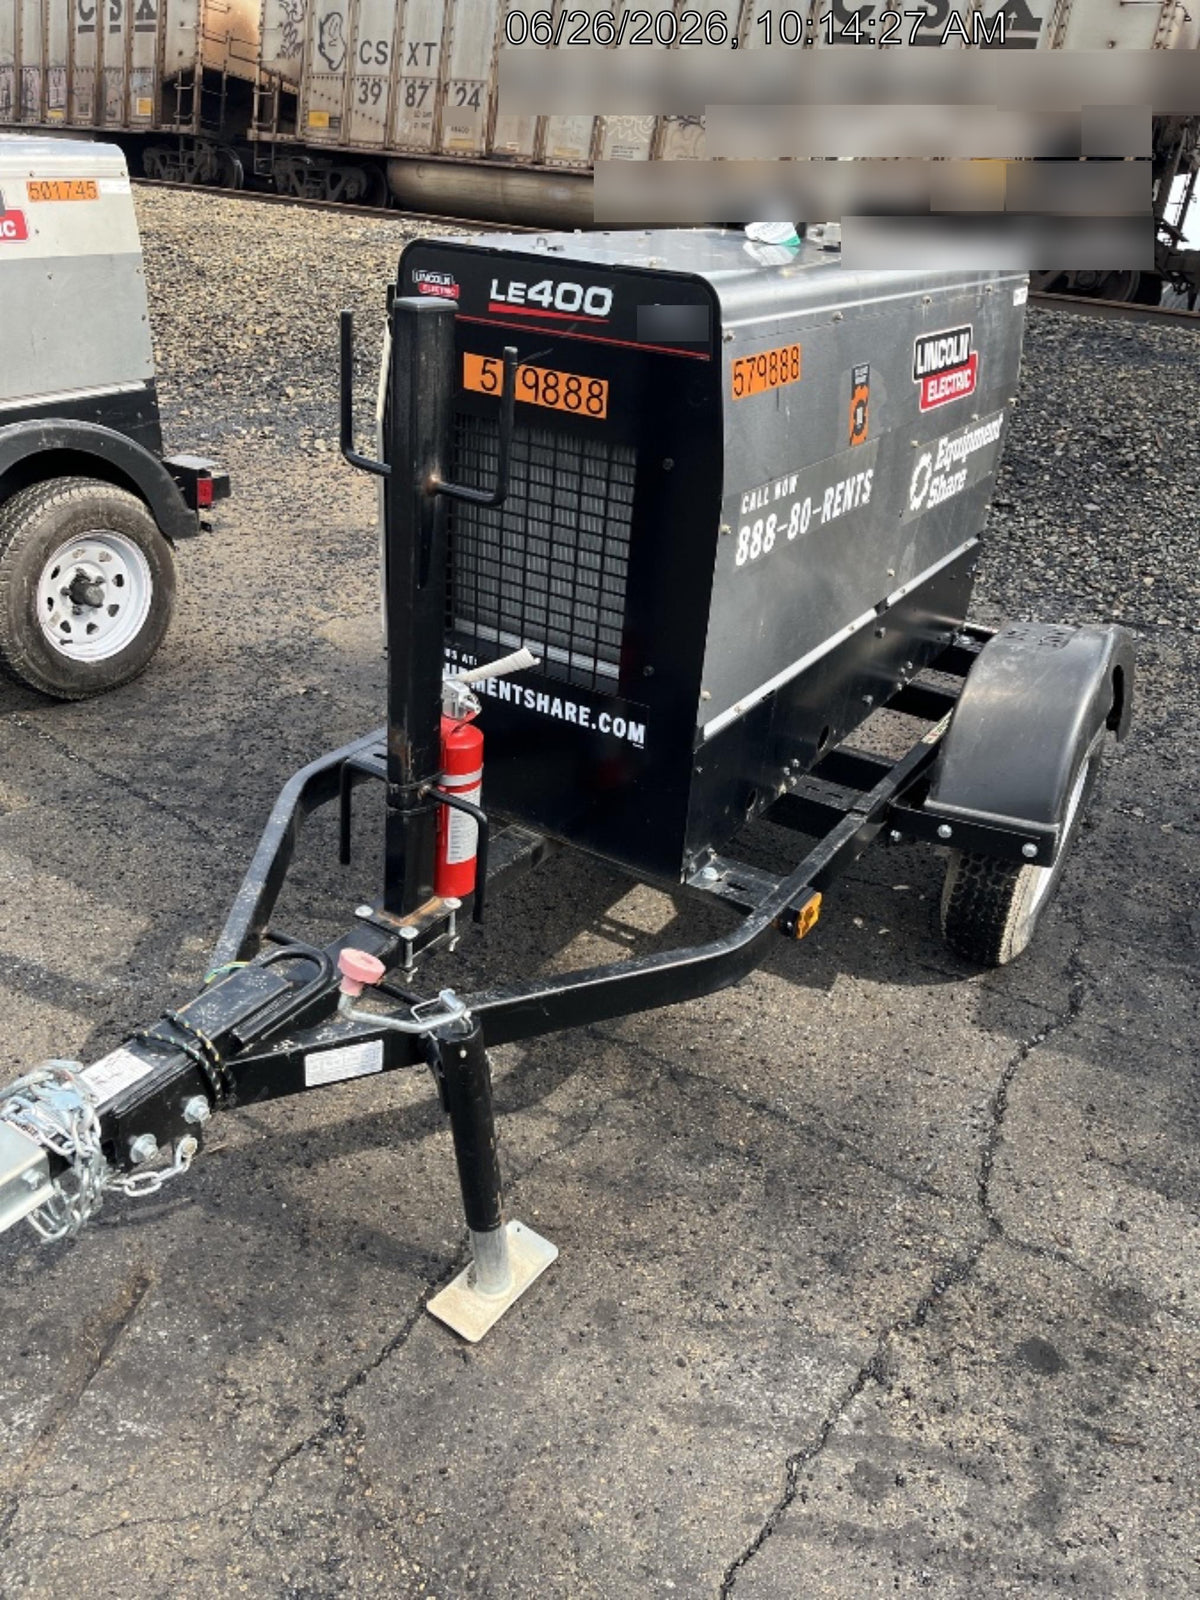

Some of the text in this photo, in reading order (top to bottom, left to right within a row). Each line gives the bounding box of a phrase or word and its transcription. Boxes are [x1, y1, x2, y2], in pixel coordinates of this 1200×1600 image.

[29, 180, 97, 200] 501745
[489, 278, 614, 317] LE400
[733, 345, 800, 397] 579888
[916, 331, 970, 375] LINCOLN
[480, 358, 604, 415] 59888
[927, 370, 972, 403] ELECTRIC
[933, 412, 1004, 472] Equipment
[741, 474, 799, 515] CALL NOW
[926, 469, 968, 510] Share
[735, 468, 875, 568] 888-80-RENTS
